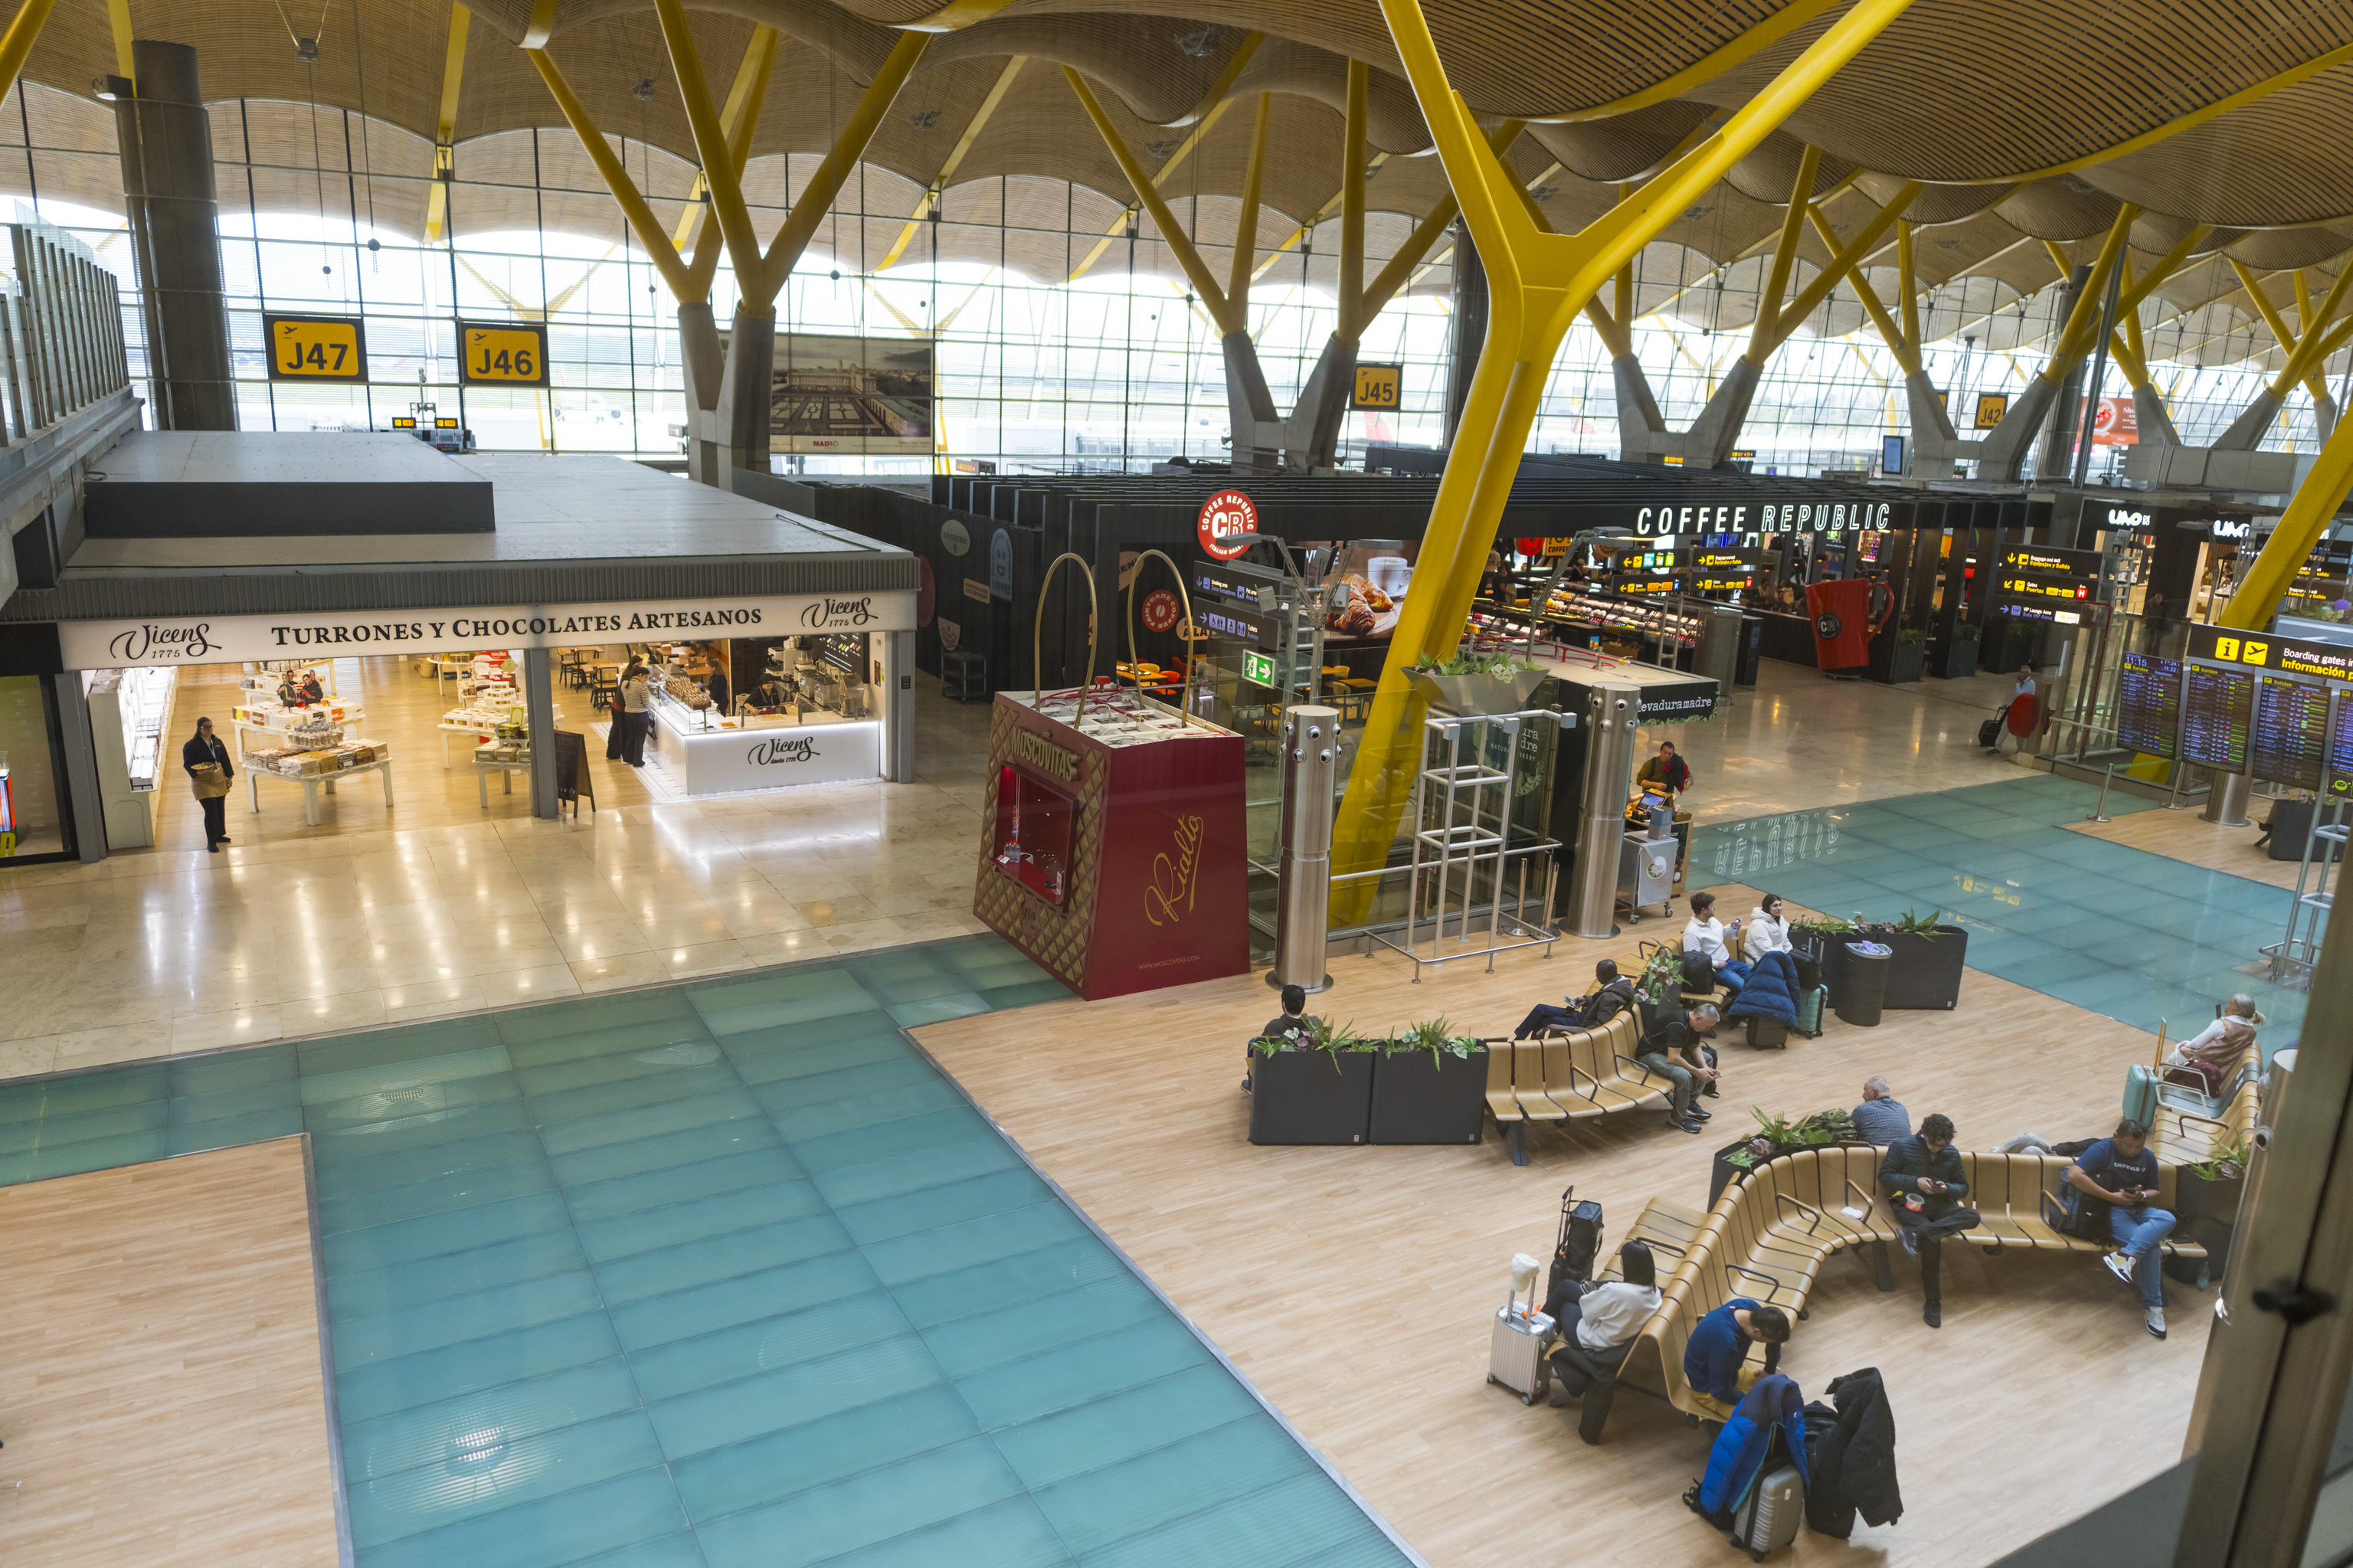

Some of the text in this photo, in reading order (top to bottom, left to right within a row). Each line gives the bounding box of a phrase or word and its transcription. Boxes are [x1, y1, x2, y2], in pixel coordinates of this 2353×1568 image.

[286, 342, 349, 370] J47
[476, 349, 533, 376] J46
[1359, 382, 1393, 402] J45
[1980, 409, 2001, 423] J42
[1202, 495, 1254, 530] COFFEE REPUBLIC
[1637, 503, 1890, 535] COFFEE REPUBLIC
[1209, 543, 1244, 555] ITALIAN ROAS
[1667, 556, 1672, 565] S
[2026, 586, 2044, 594] Puertas
[800, 597, 879, 628] Vicens
[271, 608, 762, 646] TURRONES Y CHOCOLATES ARTESANOS
[828, 619, 849, 627] 1775
[1821, 620, 1836, 633] CR
[110, 624, 222, 660] Vicens
[151, 650, 181, 659] 1775
[2126, 656, 2147, 666] 11:15
[2283, 647, 2320, 663] Boarding
[2322, 655, 2346, 666] gates
[2281, 658, 2345, 678] Información
[1638, 696, 1712, 712] evaduramadre
[748, 736, 820, 765] Vicens
[1010, 727, 1078, 782] MOSCOVITAS
[1144, 813, 1203, 926] Rialto
[1138, 954, 1200, 971] WWW.MOSCOVITAS.COM
